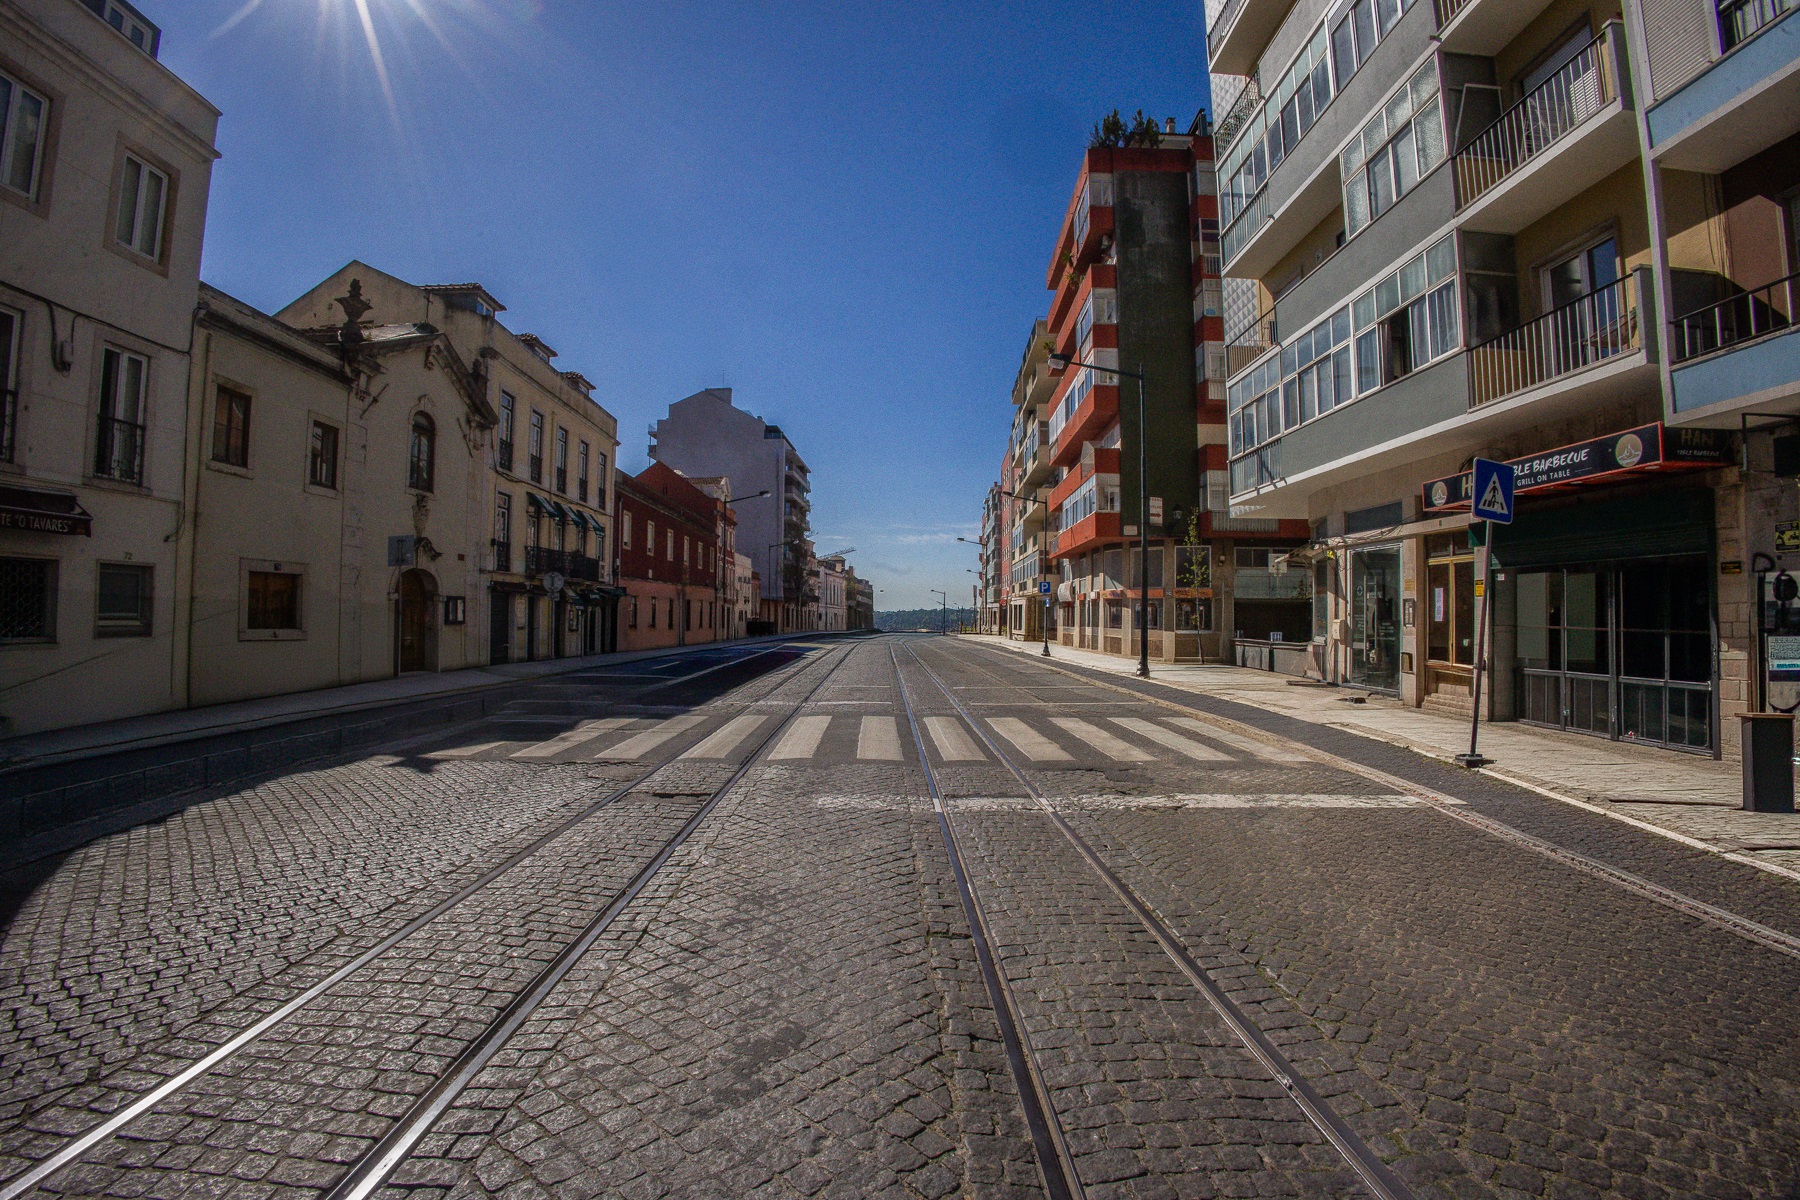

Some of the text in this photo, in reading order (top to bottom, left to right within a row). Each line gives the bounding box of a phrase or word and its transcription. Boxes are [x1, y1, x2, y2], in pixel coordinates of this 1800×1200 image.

[1513, 462, 1533, 477] BLE
[1533, 448, 1590, 473] BARBECUE
[1517, 468, 1571, 487] GRILL ON TABLE
